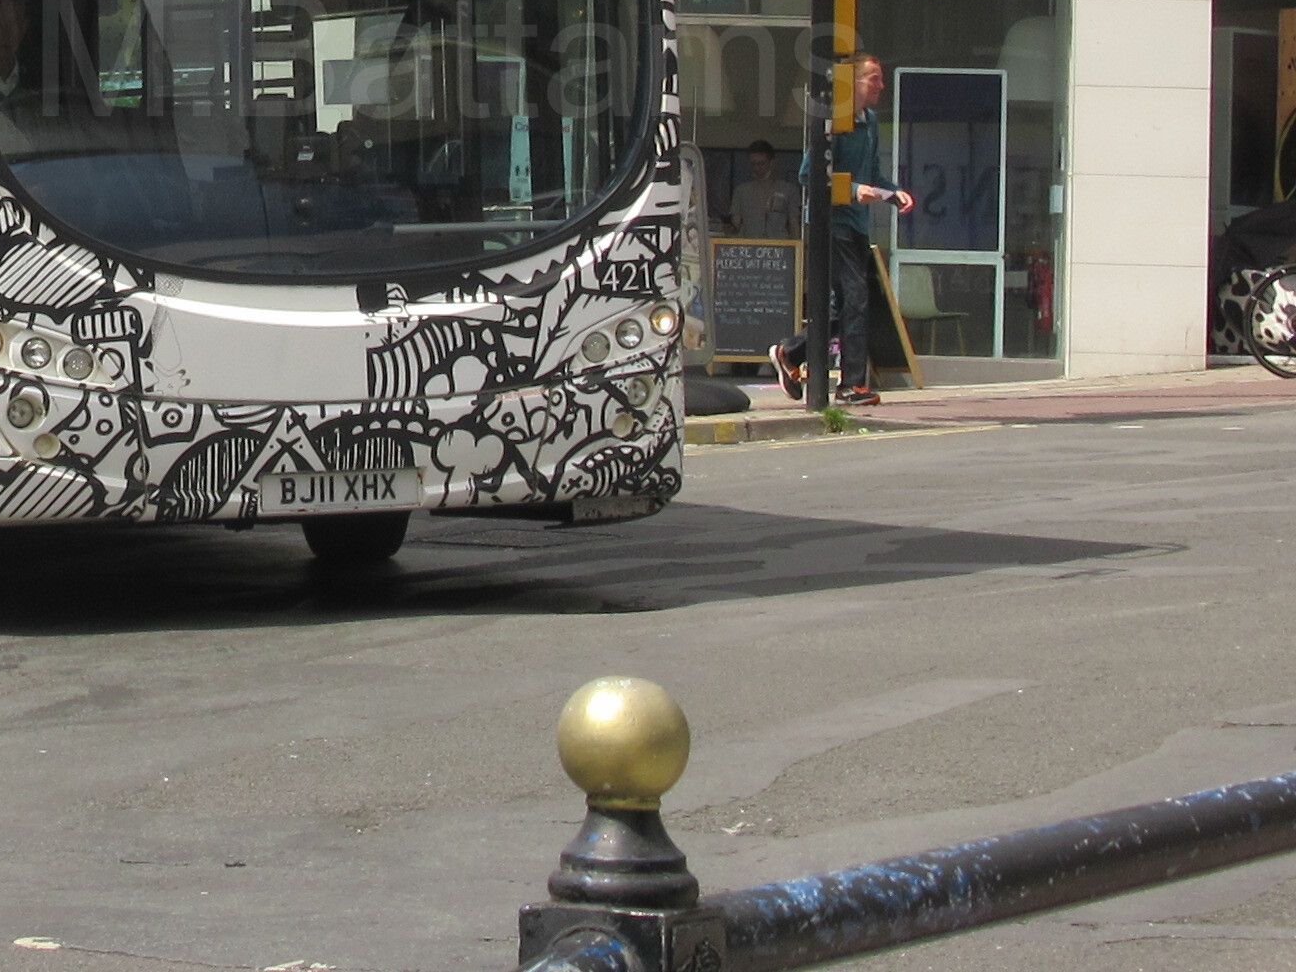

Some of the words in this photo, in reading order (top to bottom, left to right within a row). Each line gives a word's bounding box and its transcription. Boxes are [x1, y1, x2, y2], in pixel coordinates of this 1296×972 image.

[601, 260, 654, 294] 421
[280, 476, 335, 505] BJ11
[344, 473, 397, 502] XHX
